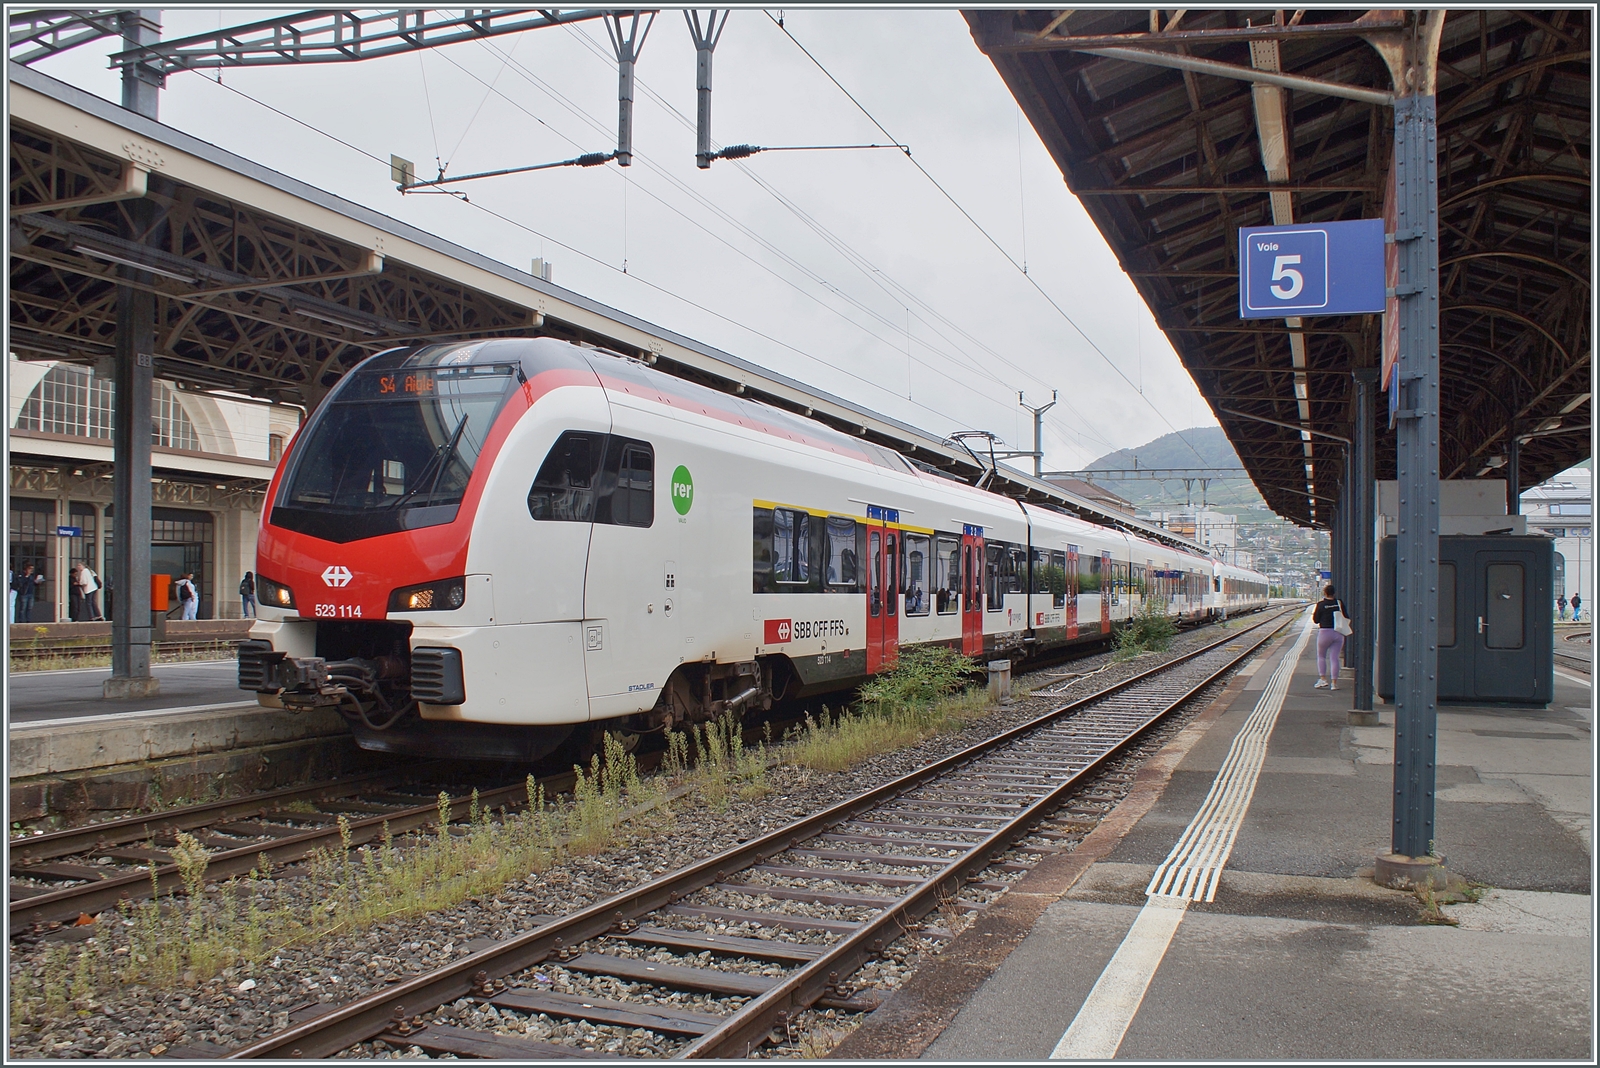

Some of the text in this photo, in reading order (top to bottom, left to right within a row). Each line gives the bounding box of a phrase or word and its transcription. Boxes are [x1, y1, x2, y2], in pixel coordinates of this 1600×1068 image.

[1257, 242, 1279, 252] Voie
[1270, 254, 1303, 300] 5
[380, 375, 434, 395] S4 Aigle
[673, 482, 692, 499] rer
[315, 604, 363, 618] 523 114
[794, 619, 845, 639] SBB CFF FFS
[628, 682, 655, 692] STADLER
